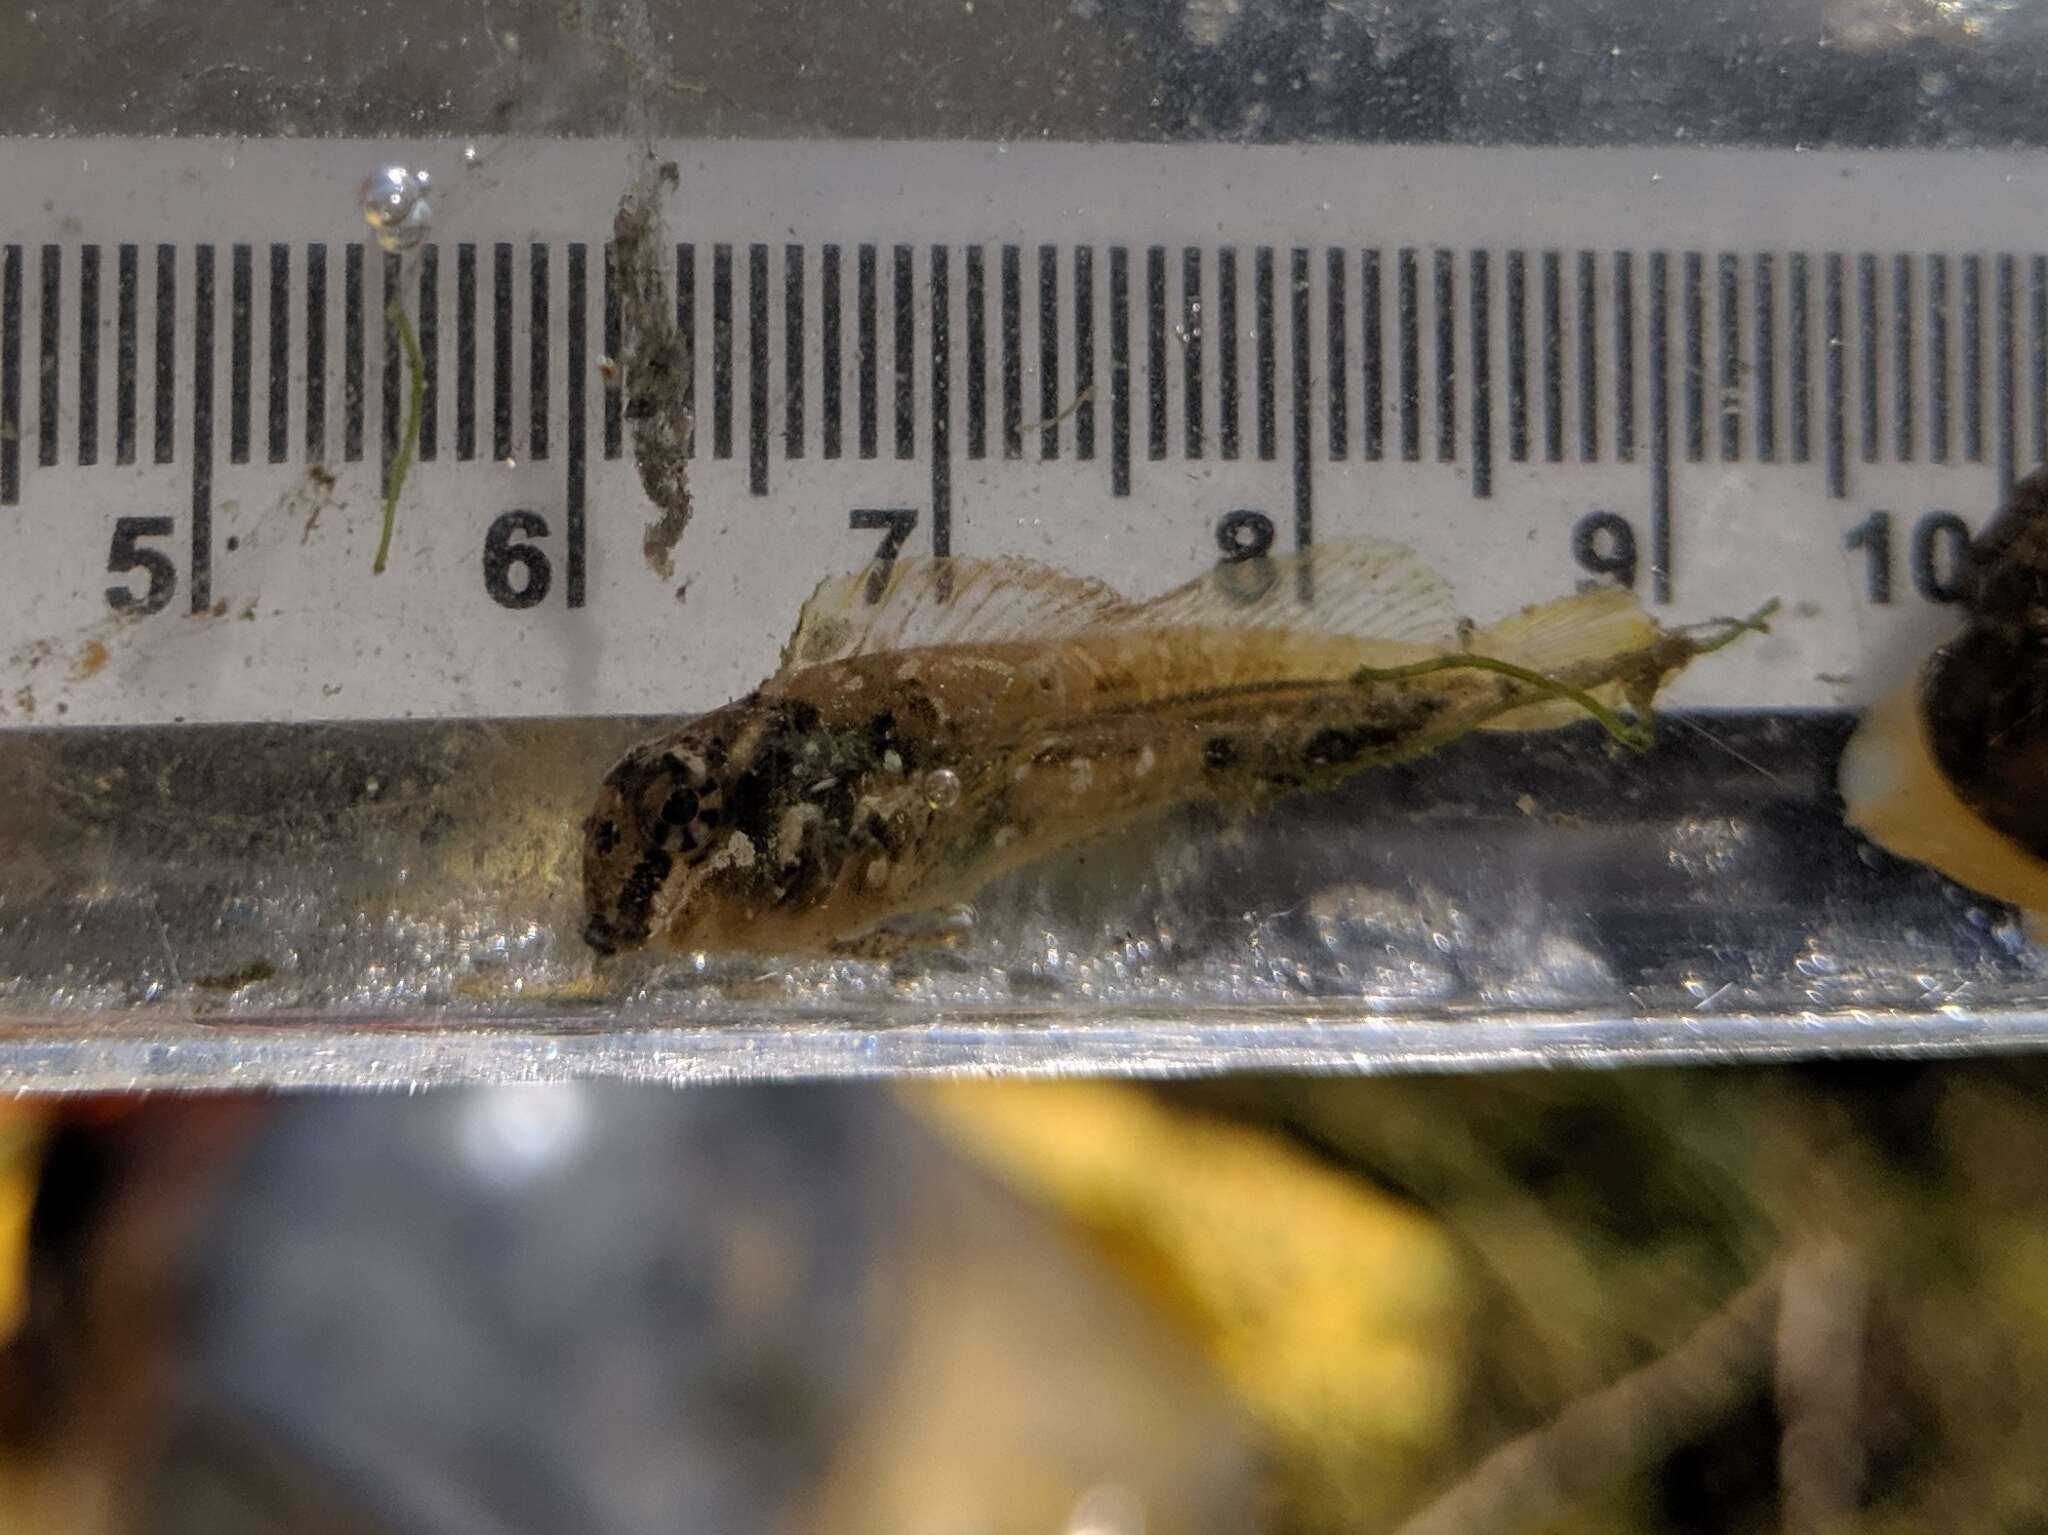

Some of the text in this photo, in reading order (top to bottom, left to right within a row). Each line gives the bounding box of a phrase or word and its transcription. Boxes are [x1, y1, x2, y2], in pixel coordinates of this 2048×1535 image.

[105, 508, 1971, 611] 5 6 7 8 9 10
